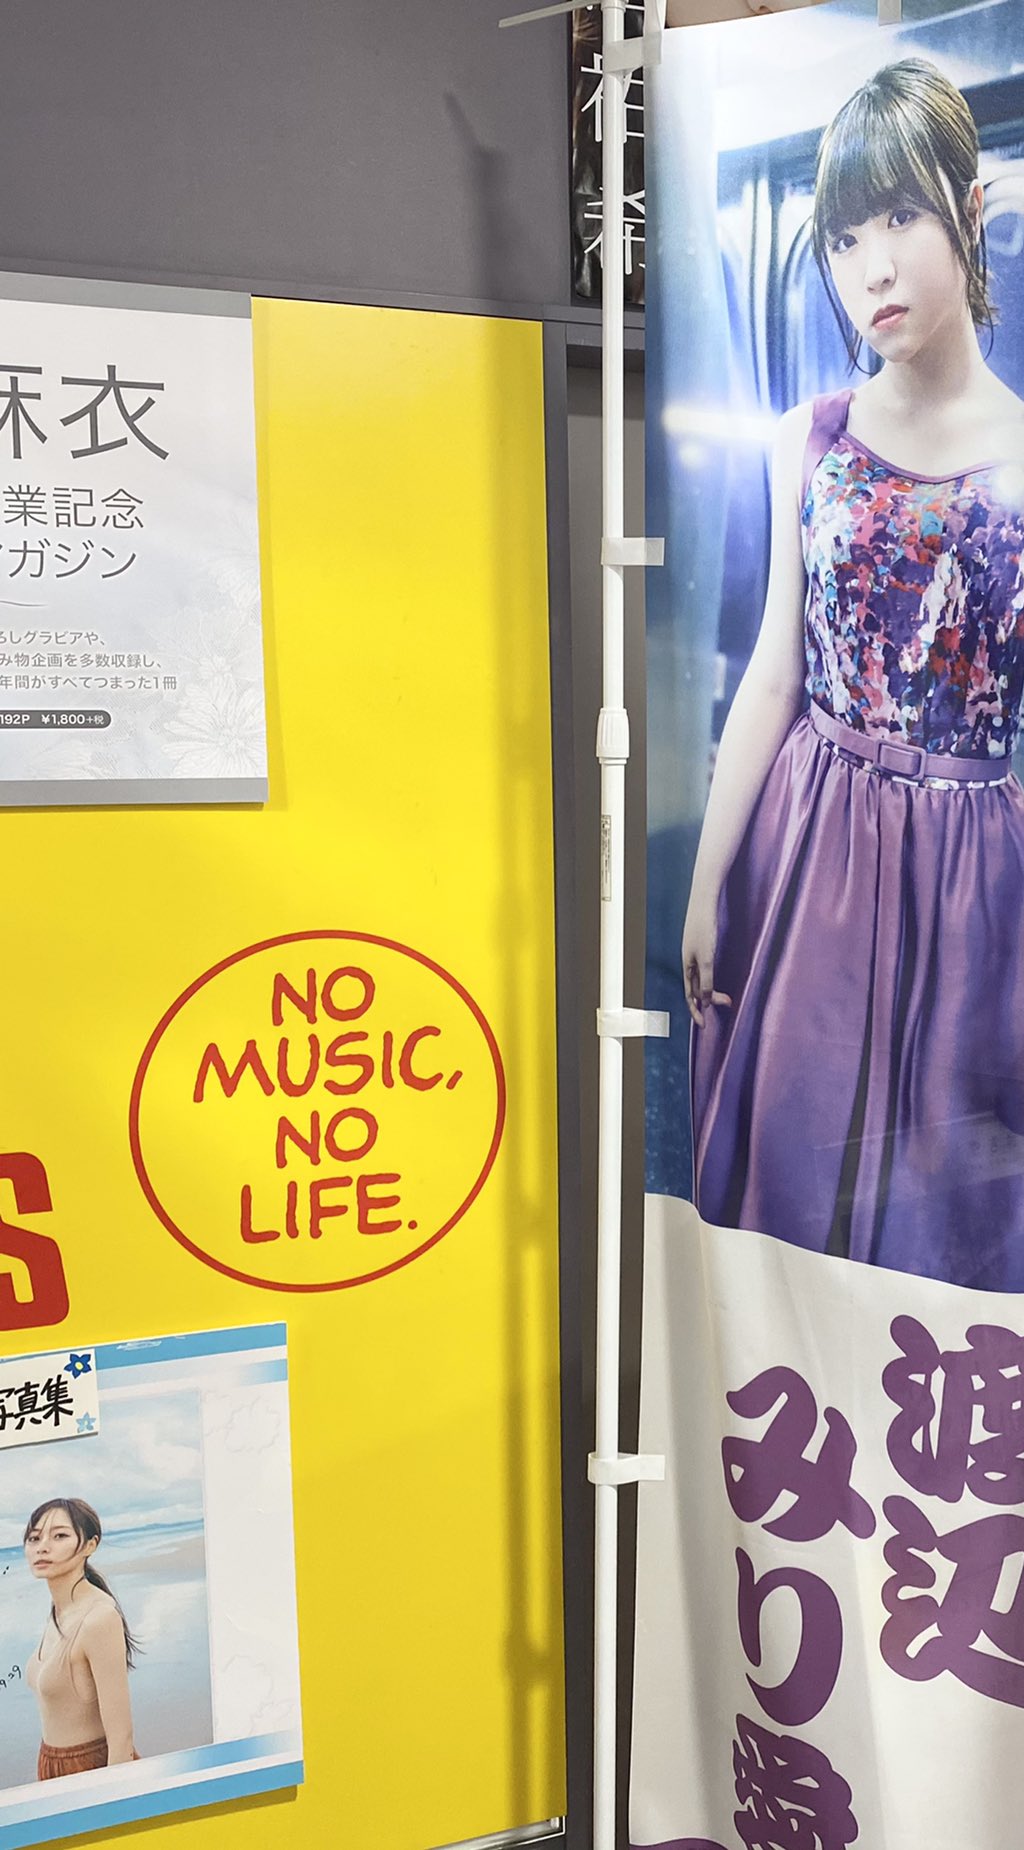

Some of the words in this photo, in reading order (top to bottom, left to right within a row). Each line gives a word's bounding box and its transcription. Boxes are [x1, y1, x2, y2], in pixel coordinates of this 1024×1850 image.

[2, 484, 144, 529] 業記念
[0, 537, 137, 579] ガジン
[271, 965, 376, 1027] NO
[192, 1025, 463, 1103] MUSIC,
[275, 1106, 379, 1169] NO
[240, 1173, 418, 1244] LIFE.
